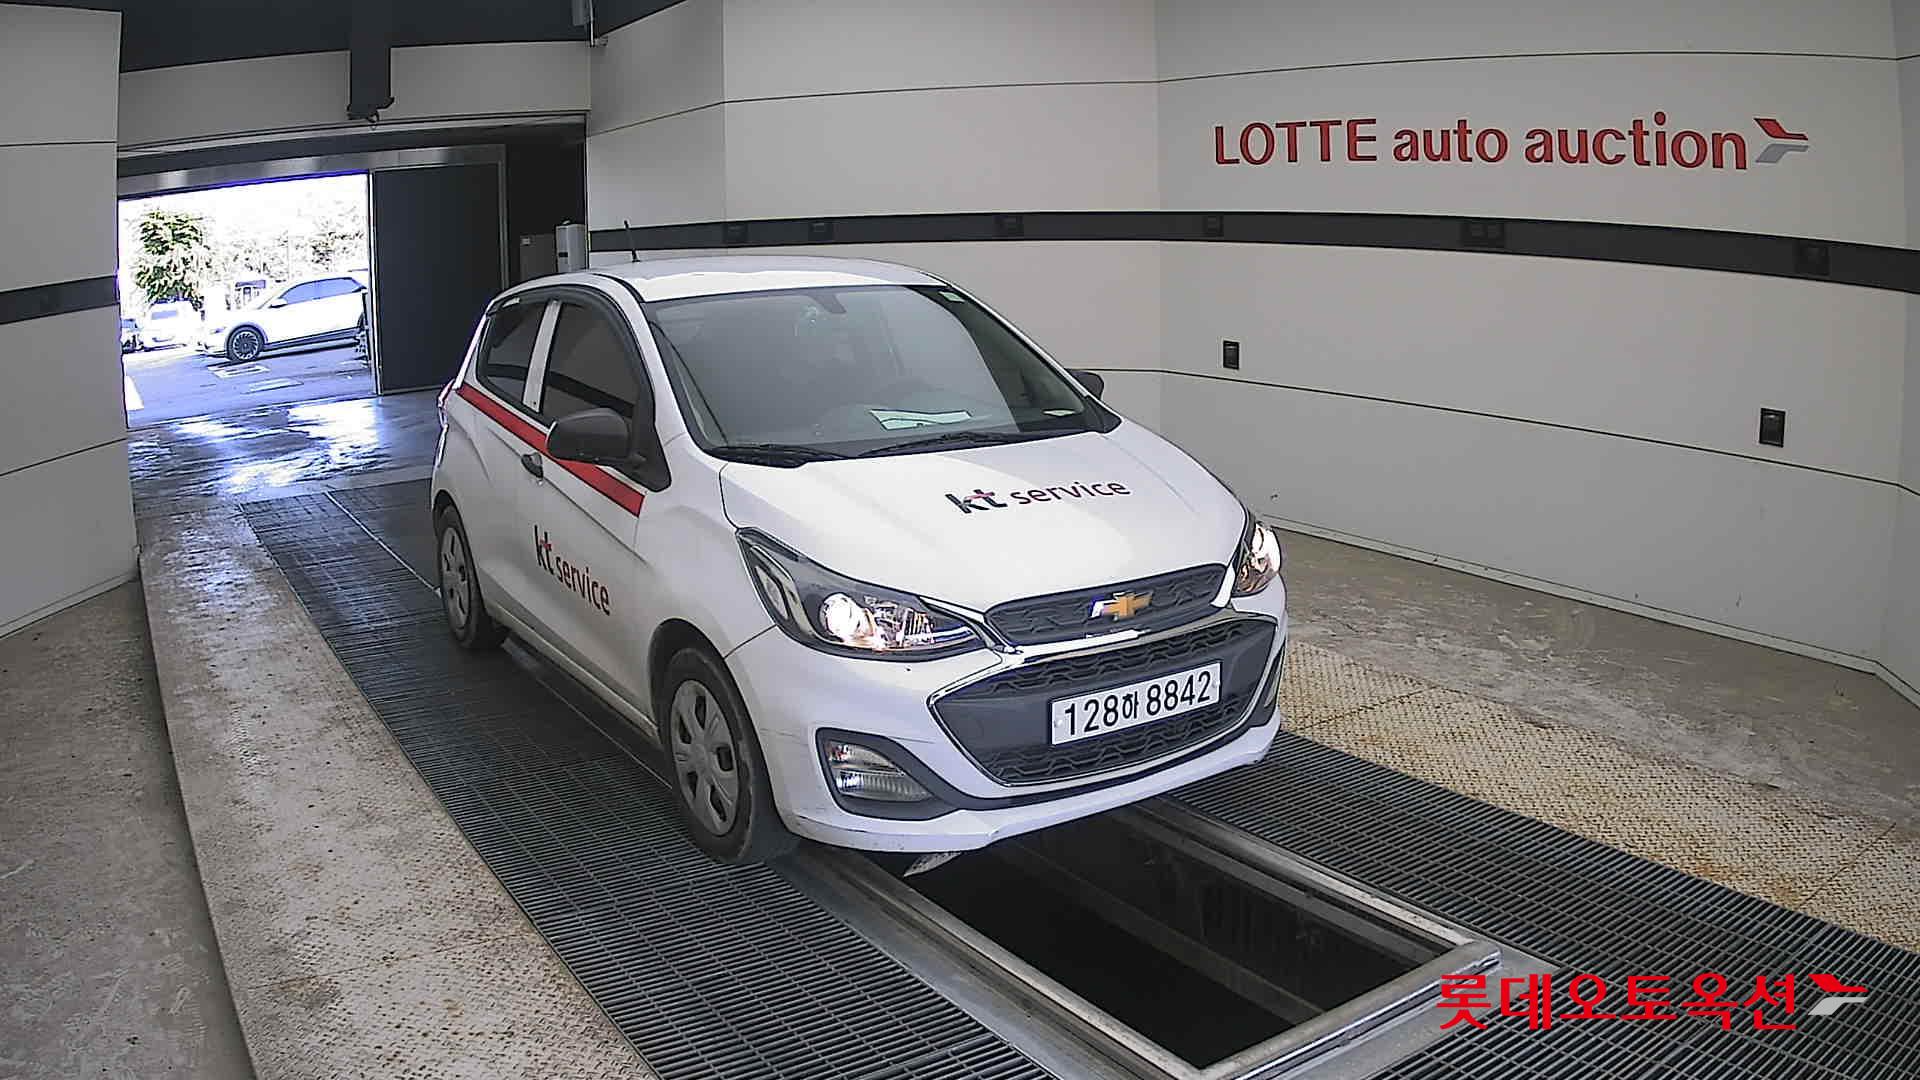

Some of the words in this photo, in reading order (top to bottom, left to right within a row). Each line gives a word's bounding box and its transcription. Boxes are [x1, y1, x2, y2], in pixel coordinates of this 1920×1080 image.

[1215, 118, 1377, 165] LOTTE
[1393, 119, 1509, 163] auto
[1524, 111, 1747, 170] auction
[945, 489, 1008, 514] kt
[1010, 481, 1131, 504] service
[534, 525, 554, 575] kt
[556, 556, 610, 616] service
[1065, 691, 1139, 735] 128하
[1146, 671, 1212, 716] 8842
